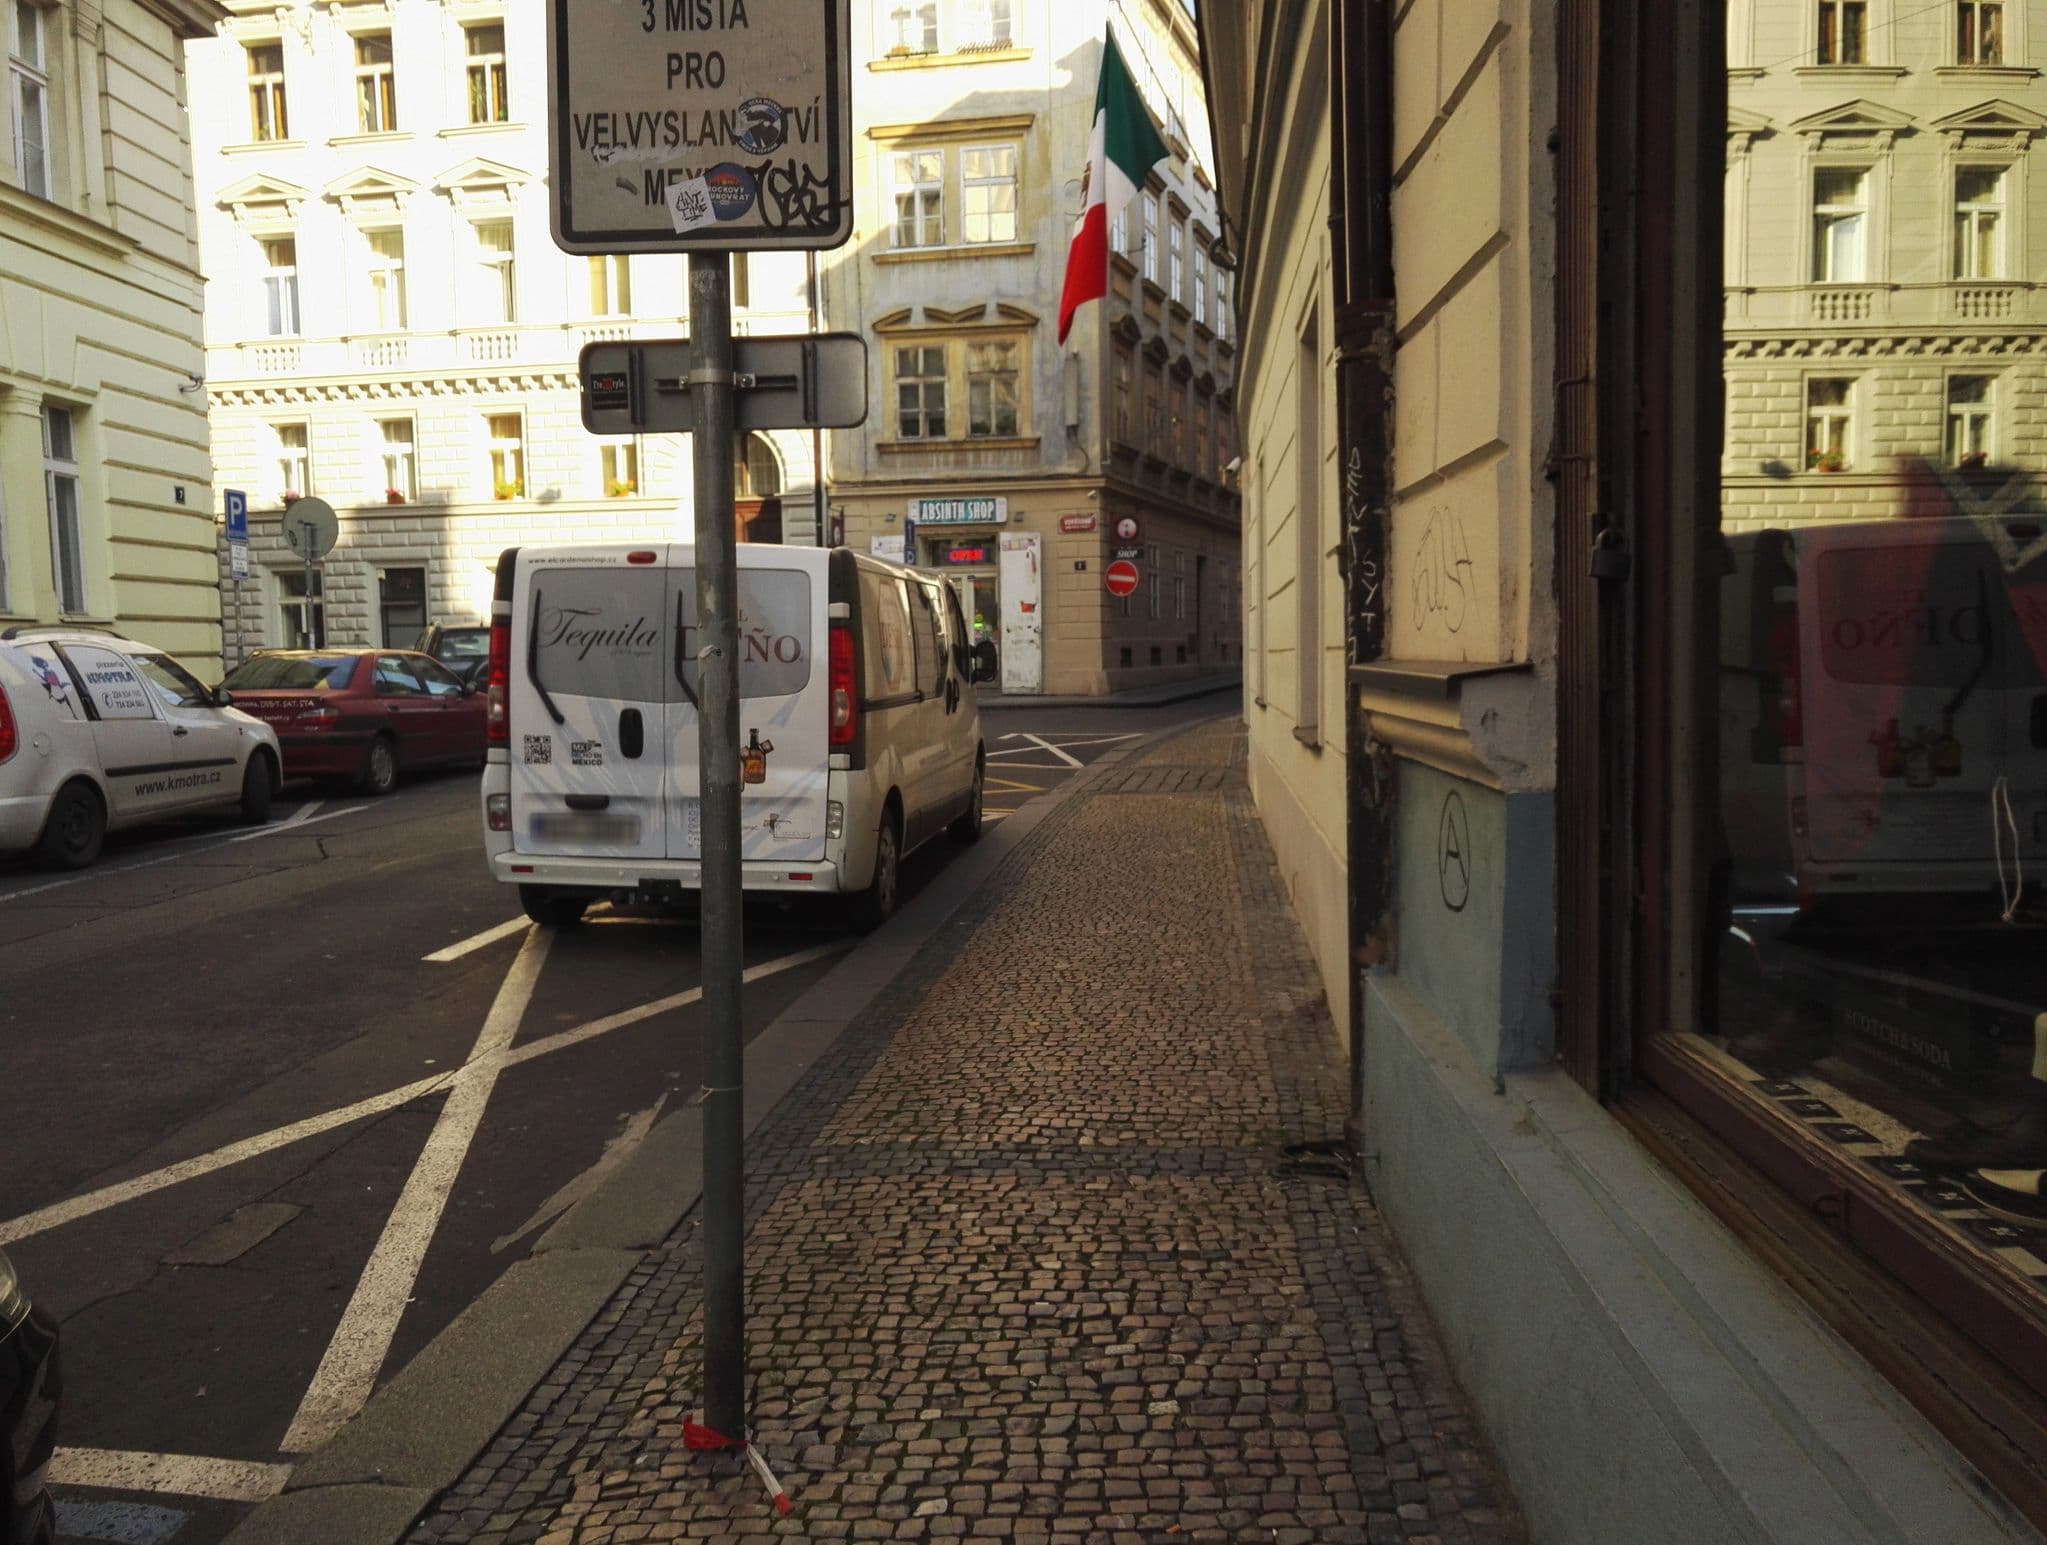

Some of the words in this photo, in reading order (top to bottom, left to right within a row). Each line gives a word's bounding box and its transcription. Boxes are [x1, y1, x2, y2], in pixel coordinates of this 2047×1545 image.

[641, 0, 656, 32] 3
[666, 51, 726, 90] PRO
[573, 96, 821, 150] VELVYSLANTVÍ
[230, 496, 242, 525] P
[921, 502, 965, 520] ABSINTH
[967, 501, 994, 519] SHOP
[538, 607, 657, 661] Tequila
[135, 772, 221, 796] www.kmotra.cz
